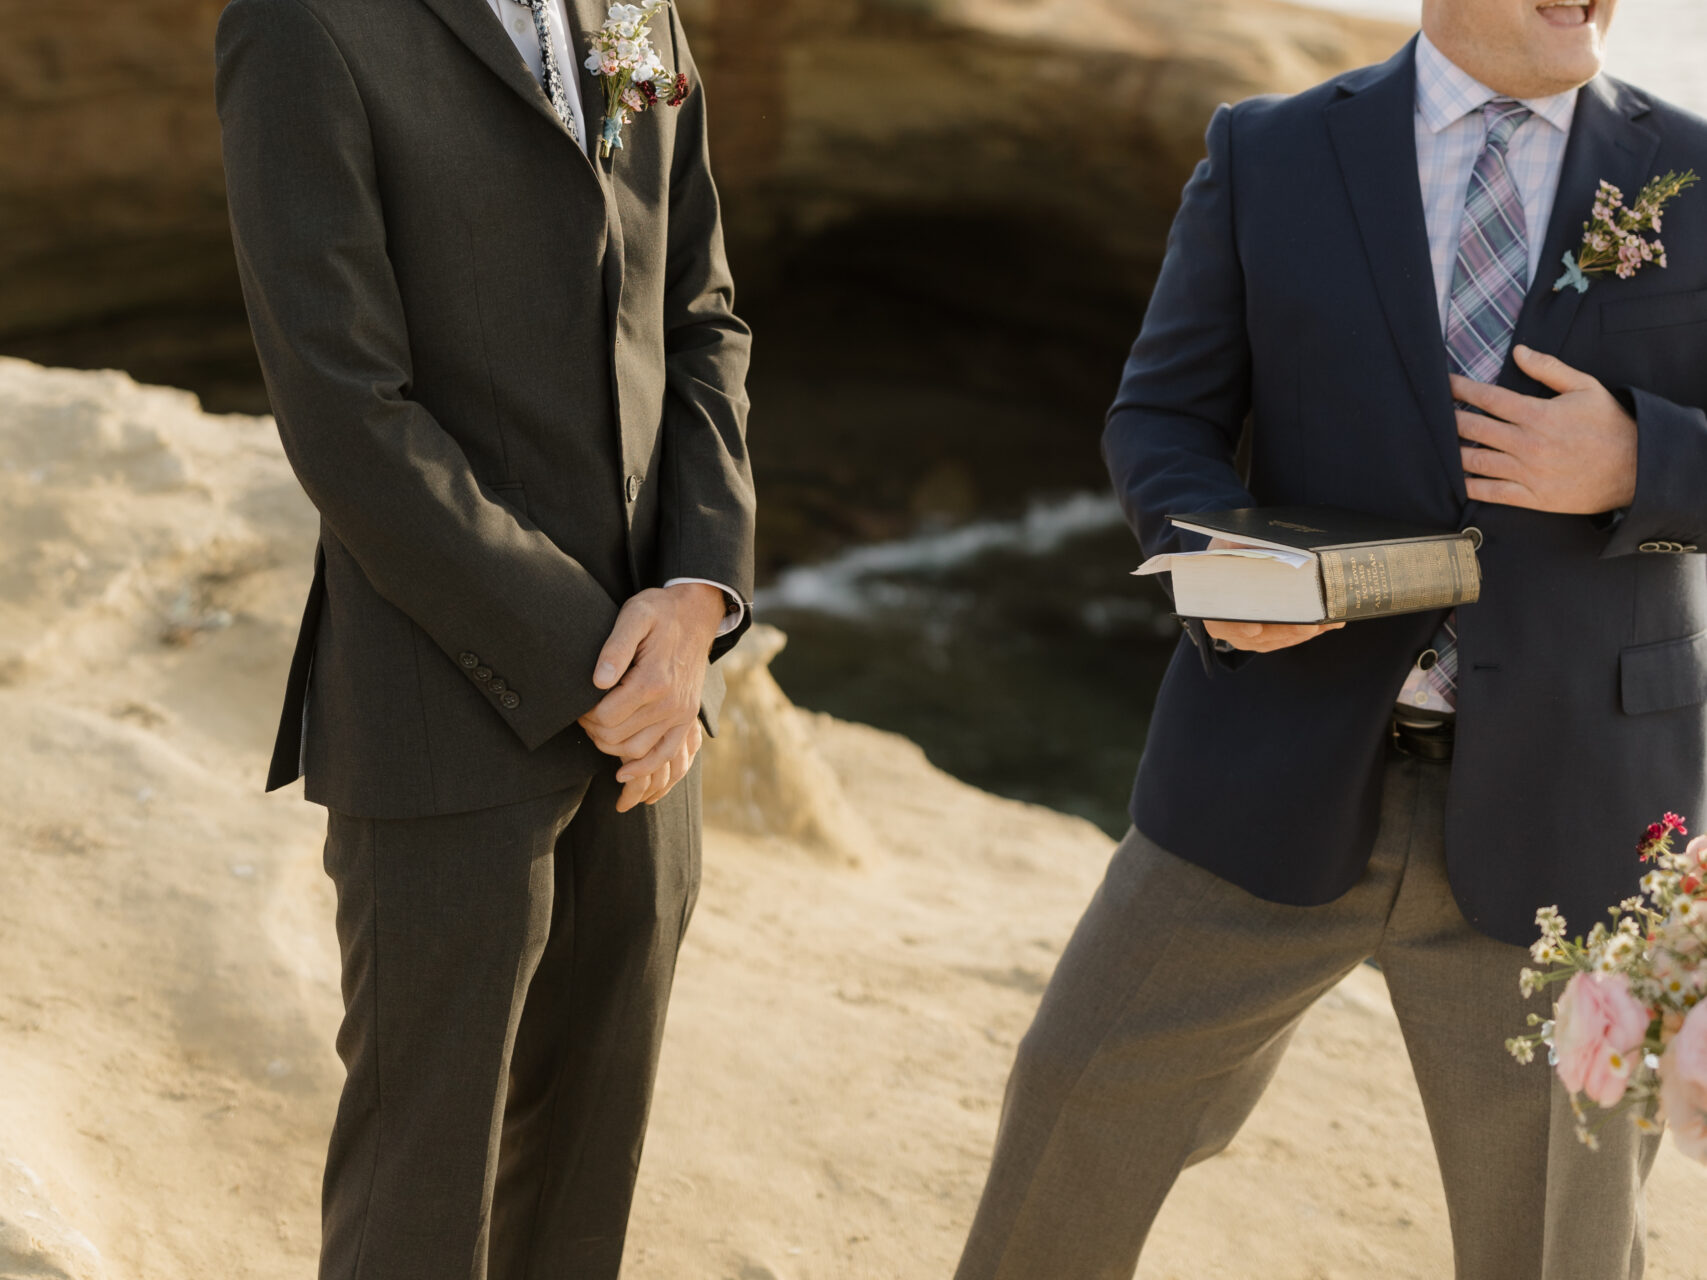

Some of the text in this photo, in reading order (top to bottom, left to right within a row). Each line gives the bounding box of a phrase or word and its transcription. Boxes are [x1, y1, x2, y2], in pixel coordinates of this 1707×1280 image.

[1351, 557, 1359, 585] LOVED
[1359, 564, 1369, 599] POEMS
[1369, 553, 1381, 608] AMERICAN
[1378, 561, 1389, 599] PEOPLE
